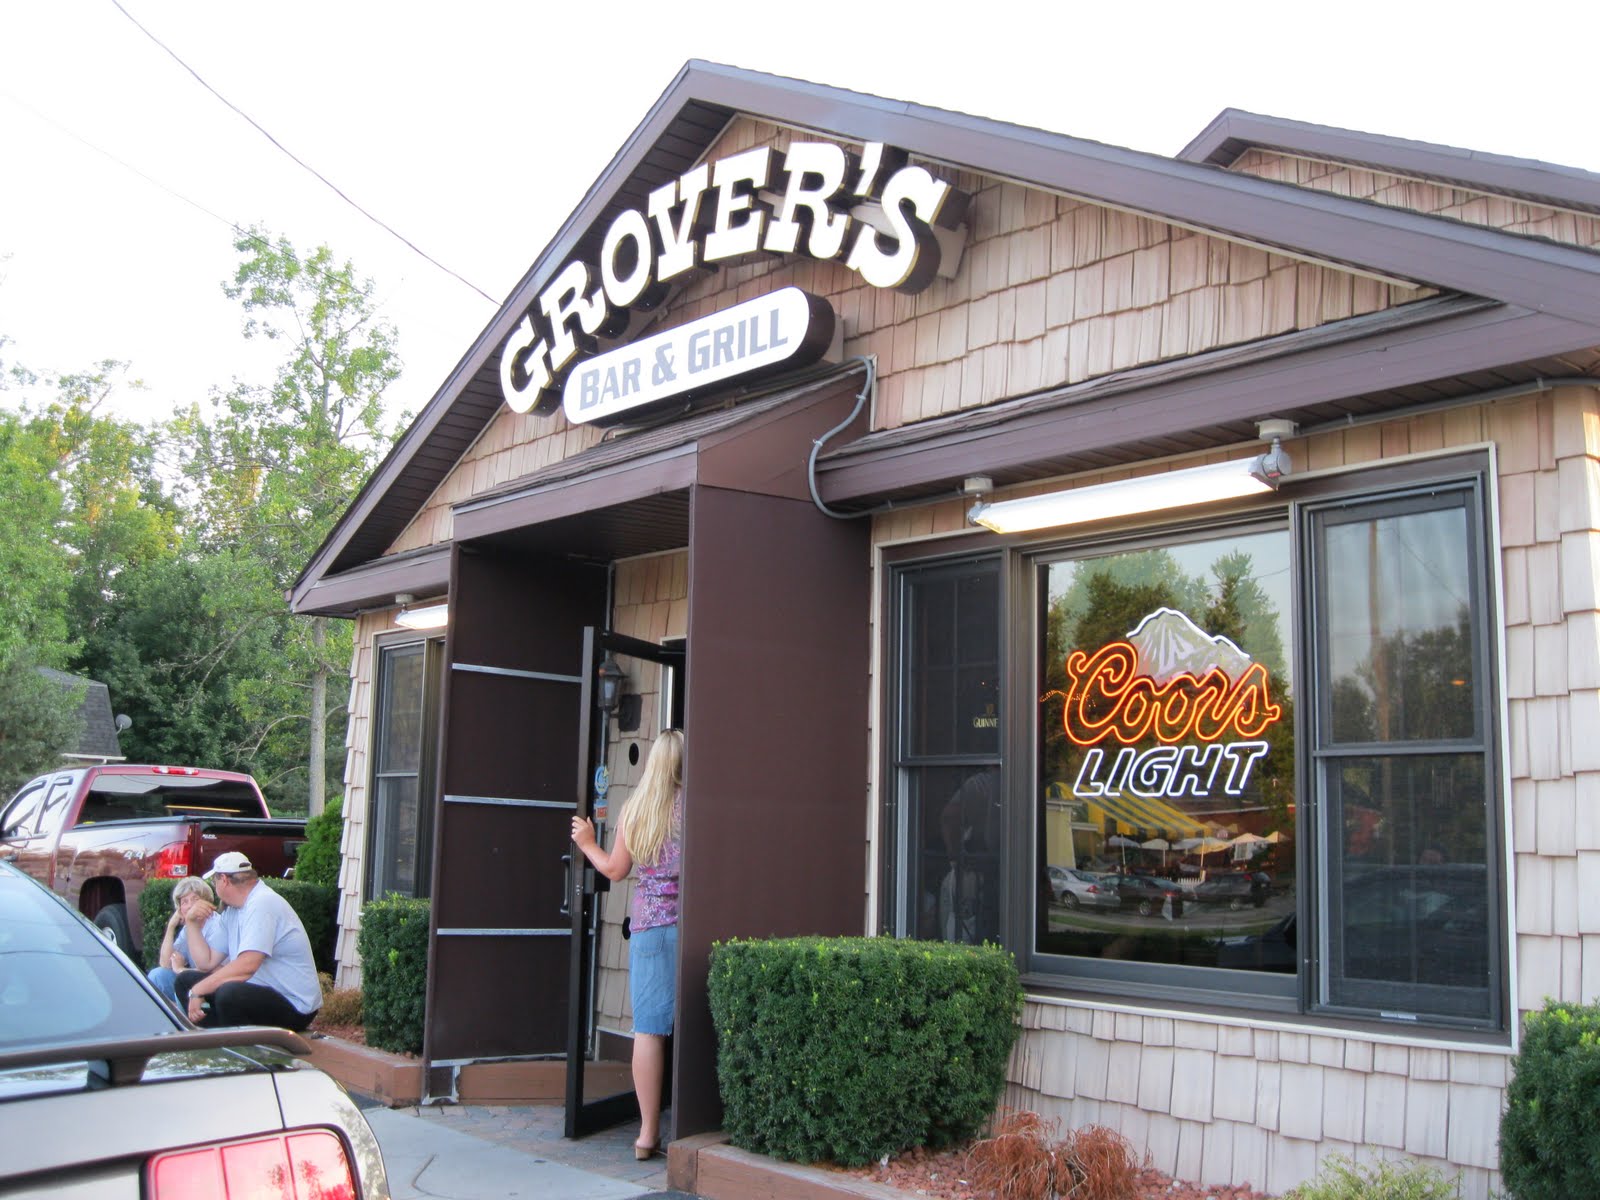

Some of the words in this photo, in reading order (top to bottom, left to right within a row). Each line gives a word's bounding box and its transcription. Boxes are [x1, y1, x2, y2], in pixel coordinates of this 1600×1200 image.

[500, 142, 948, 414] GROVER'S
[579, 356, 641, 411] BAR
[651, 342, 677, 387] &
[687, 308, 789, 375] GRILL
[1063, 642, 1281, 745] Coors
[1073, 741, 1268, 797] LIGHT
